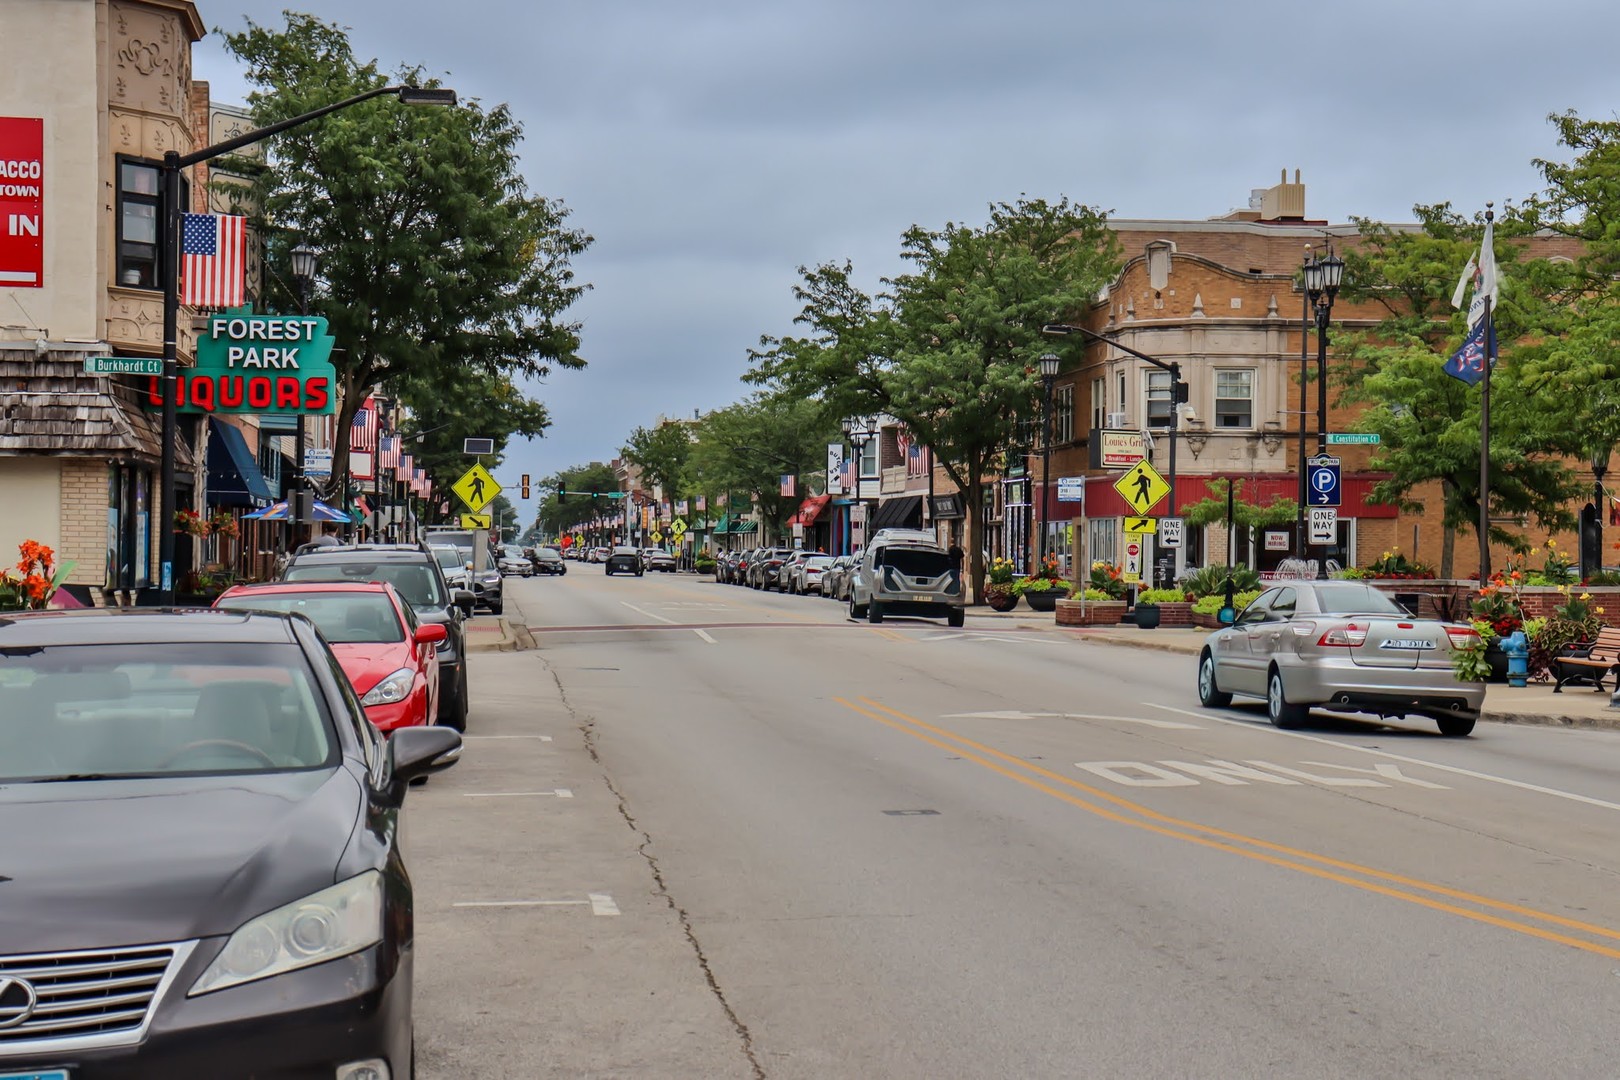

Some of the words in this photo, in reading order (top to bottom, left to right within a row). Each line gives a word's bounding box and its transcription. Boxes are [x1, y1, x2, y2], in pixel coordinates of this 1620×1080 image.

[0, 160, 40, 179] ACCO
[8, 214, 39, 237] IN
[212, 318, 317, 341] FOREST
[98, 359, 144, 372] Burkhardt
[147, 361, 158, 373] Ct
[228, 346, 300, 369] PARK
[149, 375, 328, 412] LIQUORS
[1104, 435, 1128, 447] Louie's
[1129, 436, 1144, 448] Gril
[1335, 434, 1369, 443] Constitution
[1318, 472, 1332, 490] P
[1313, 511, 1333, 520] ONE
[1164, 521, 1180, 529] ONE
[1313, 521, 1333, 530] WAY
[1073, 759, 1453, 791] ONLY
